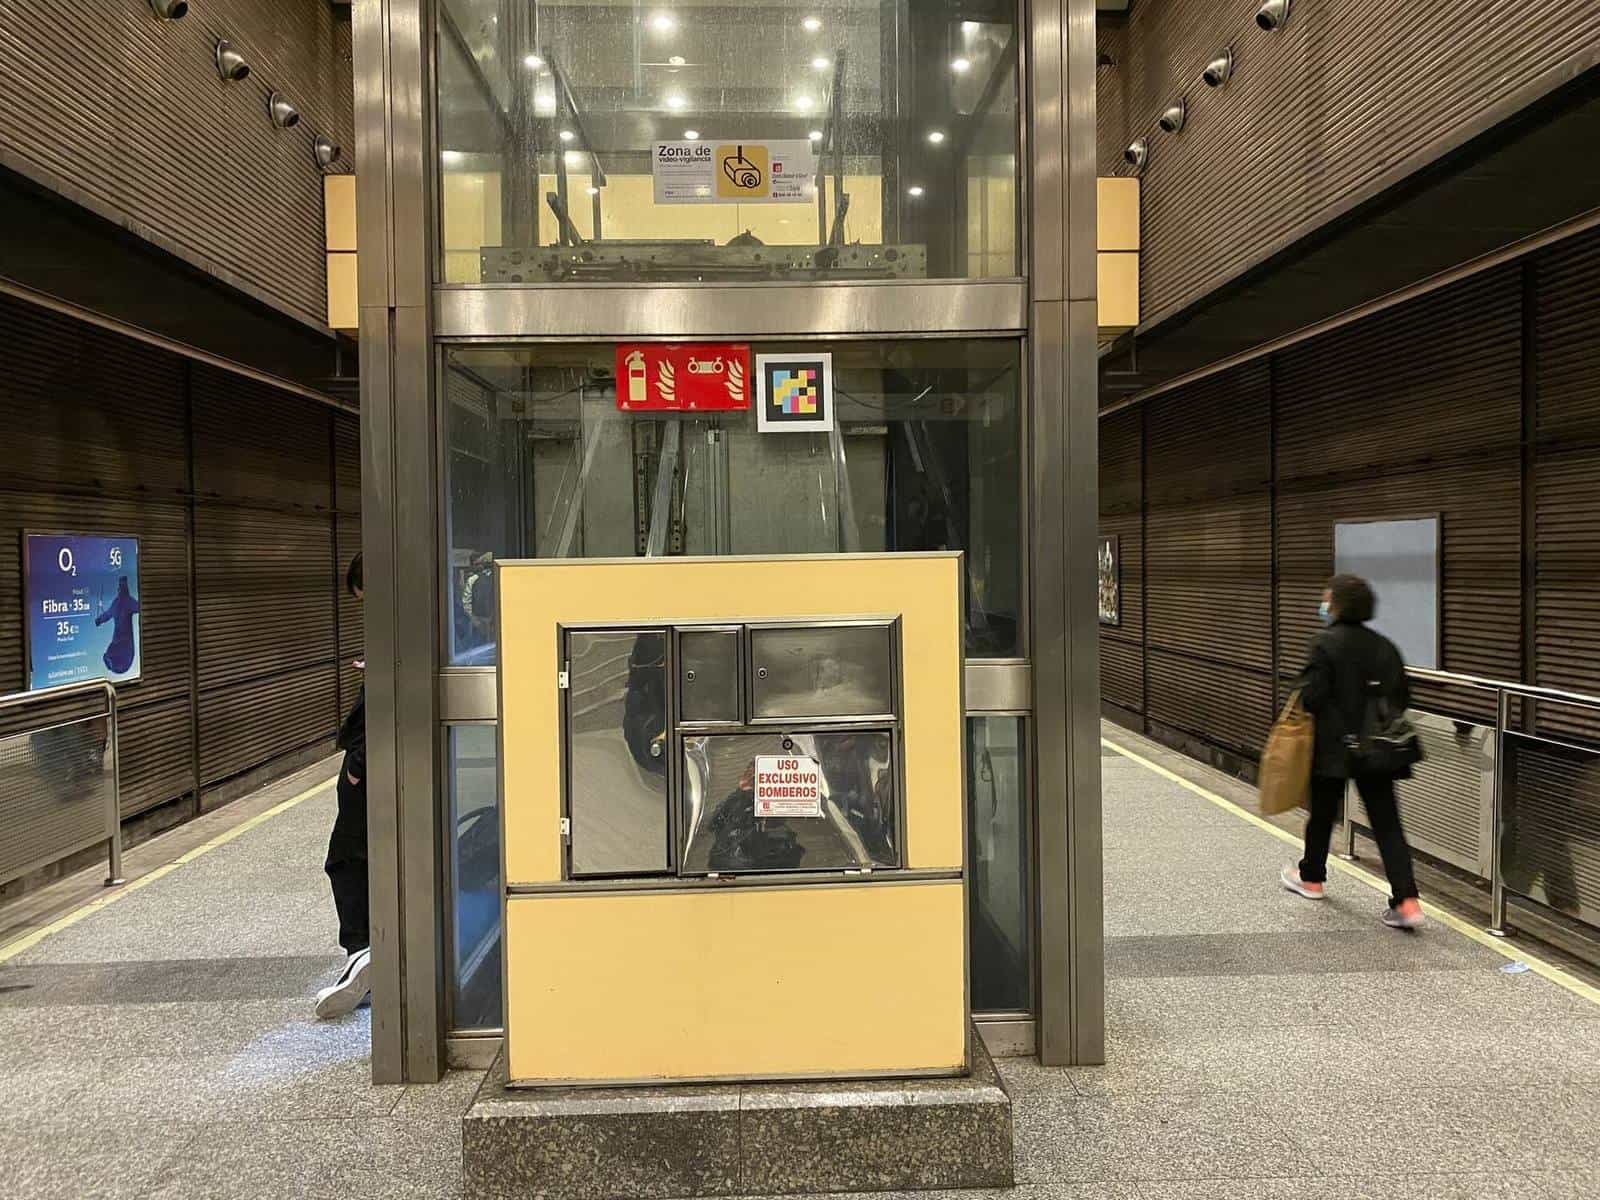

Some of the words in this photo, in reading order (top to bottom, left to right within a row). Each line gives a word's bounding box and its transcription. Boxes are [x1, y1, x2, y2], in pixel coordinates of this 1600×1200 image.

[658, 145, 691, 157] Zona
[695, 145, 711, 157] de
[109, 548, 122, 566] 5G
[42, 599, 69, 614] Fibra
[777, 759, 799, 770] USO
[758, 773, 817, 784] EXCLUSIVO
[758, 786, 817, 798] BOMBEROS
